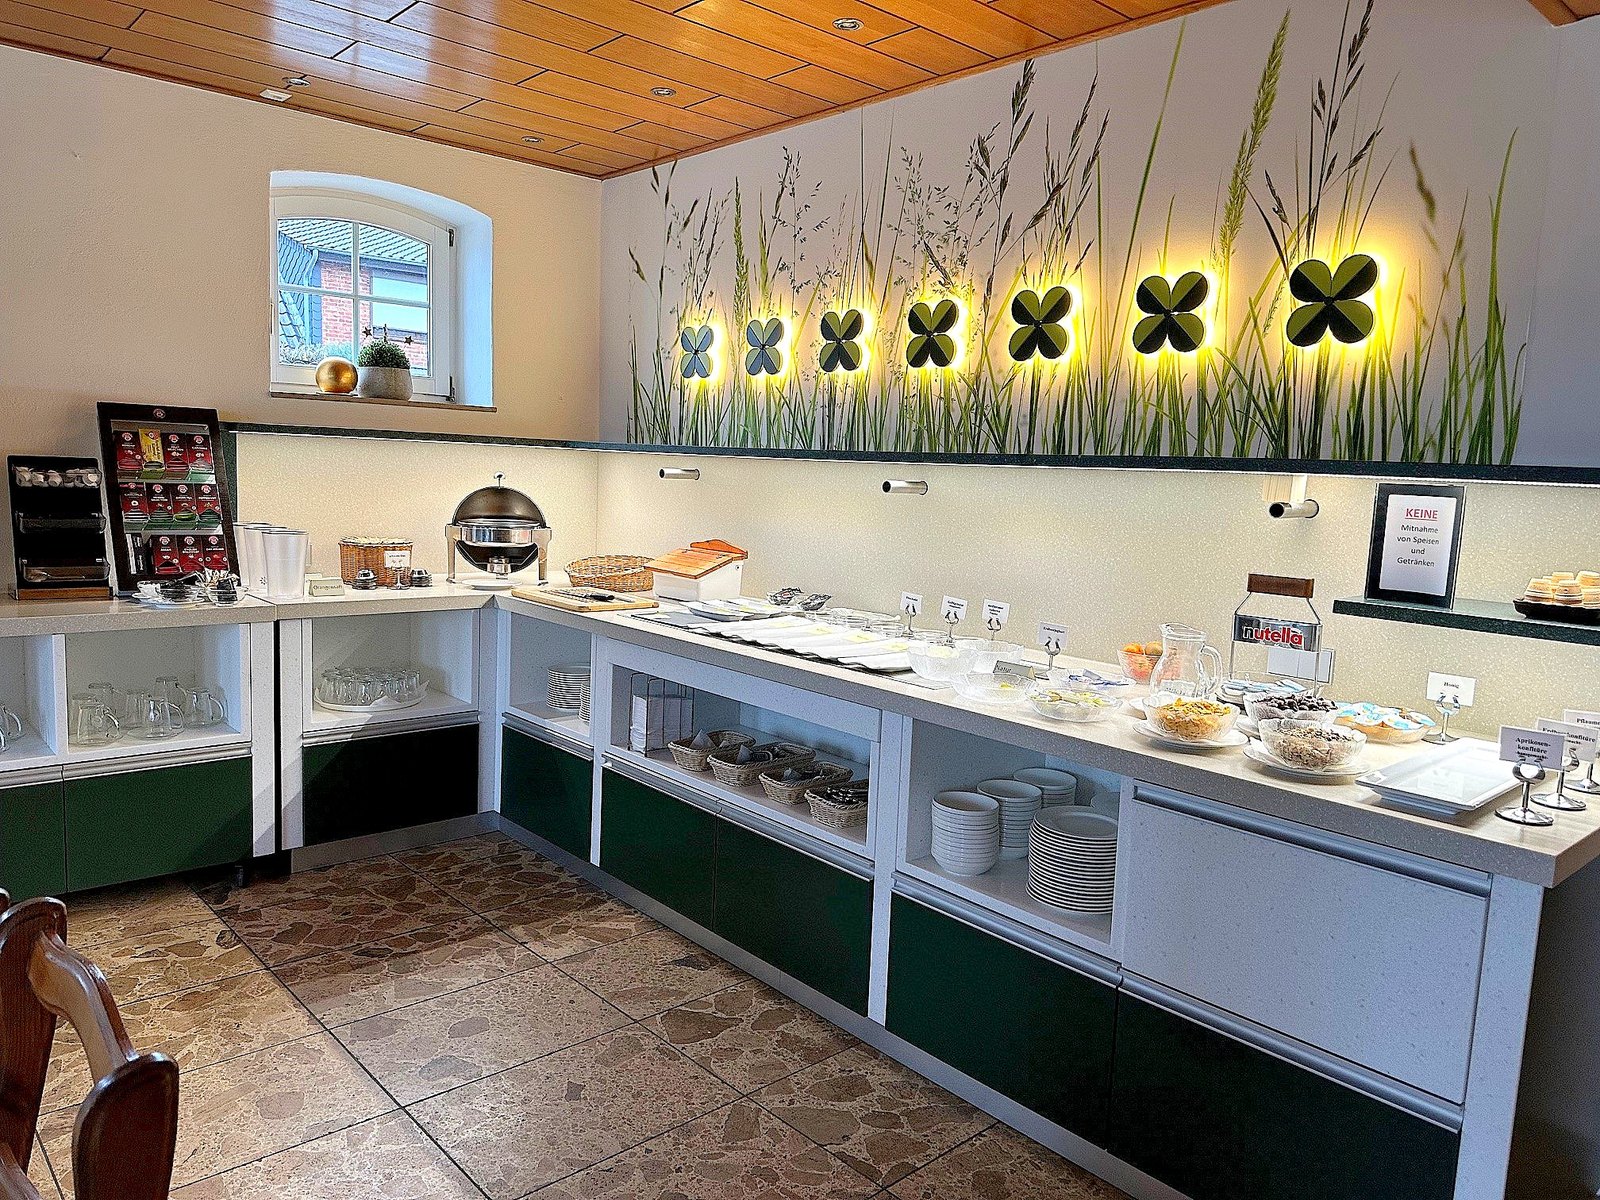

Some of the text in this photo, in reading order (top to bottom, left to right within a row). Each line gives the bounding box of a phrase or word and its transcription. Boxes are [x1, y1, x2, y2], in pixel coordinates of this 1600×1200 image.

[1405, 508, 1438, 520] KEINE
[1401, 525, 1438, 533] Mitnahme
[1412, 536, 1440, 545] Speisen
[1410, 547, 1426, 555] und
[1397, 557, 1435, 567] Getränken
[1242, 625, 1304, 646] nutella
[1516, 738, 1551, 747] Aprikosen-
[1517, 744, 1548, 754] konfitüre
